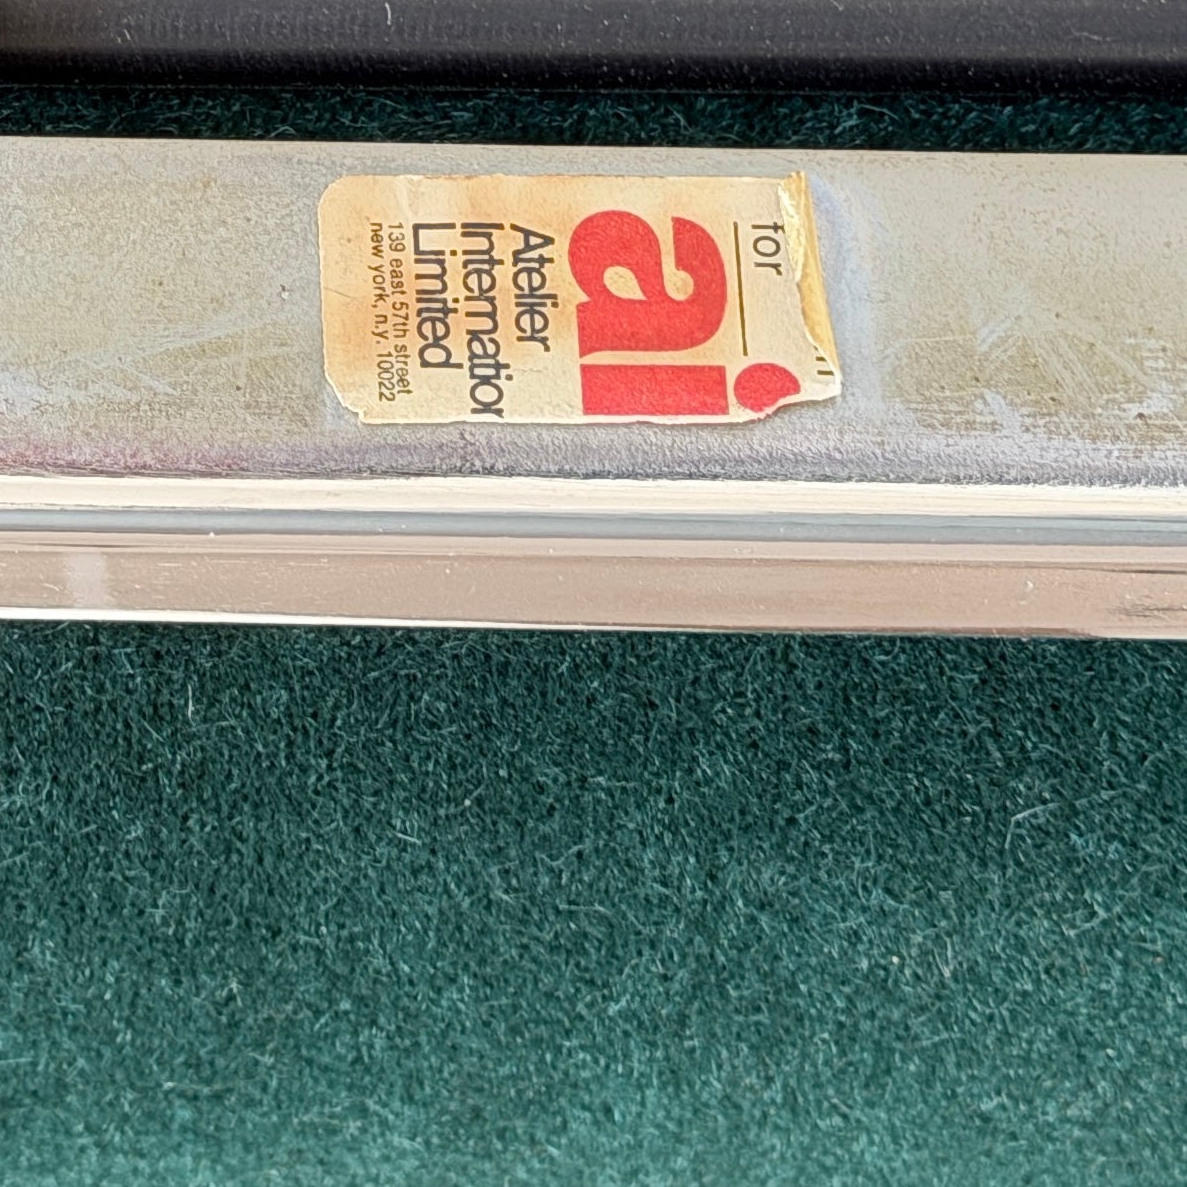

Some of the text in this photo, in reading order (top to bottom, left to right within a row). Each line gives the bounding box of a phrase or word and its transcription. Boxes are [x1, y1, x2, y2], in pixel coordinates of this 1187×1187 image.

[367, 222, 397, 403] new york, n.y. 10022
[387, 221, 414, 395] 139 east 57th street
[412, 222, 464, 369] Limited
[510, 222, 559, 353] Atelier
[568, 210, 801, 419] ai
[751, 221, 786, 276] for
